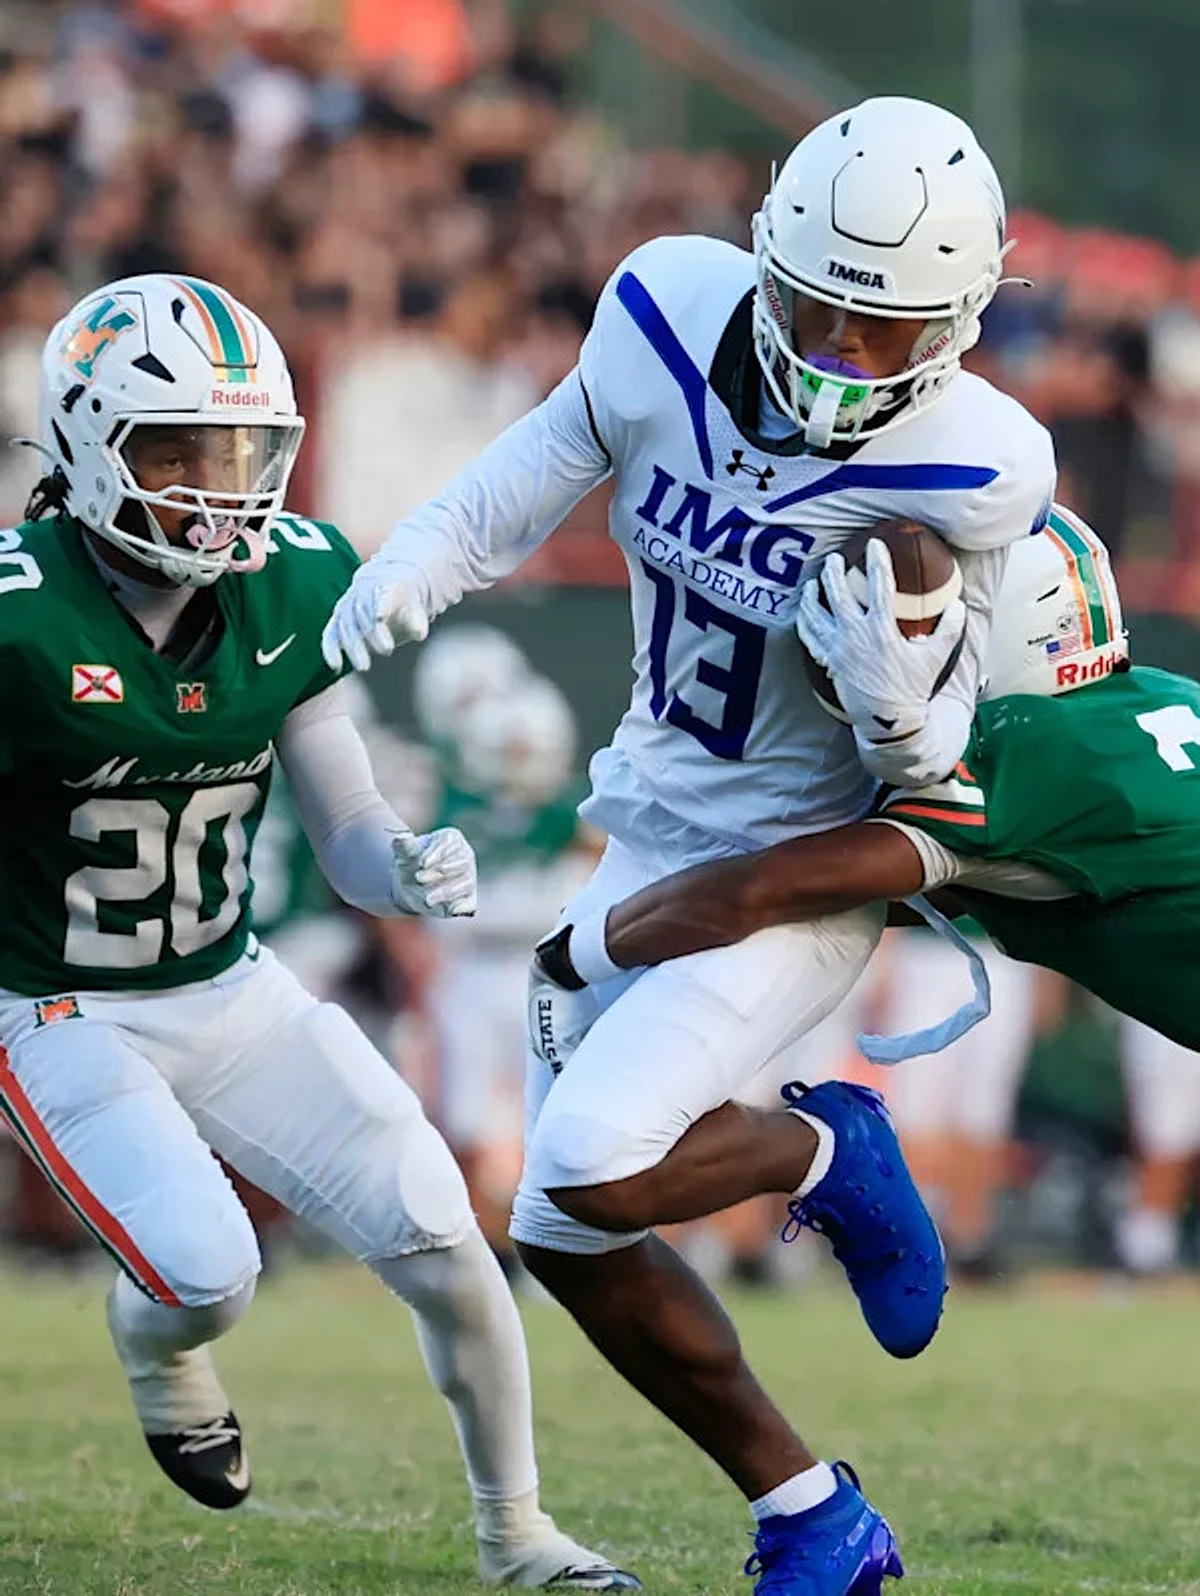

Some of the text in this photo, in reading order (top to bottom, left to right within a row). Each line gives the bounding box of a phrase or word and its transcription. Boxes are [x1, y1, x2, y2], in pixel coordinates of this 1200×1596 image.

[827, 260, 886, 290] IMGA
[210, 389, 271, 408] Riddell
[635, 464, 816, 589] IMG
[633, 527, 791, 616] ACADEMY
[640, 556, 767, 761] 13
[1056, 651, 1123, 687] Ridd
[63, 781, 262, 969] 20
[537, 1000, 557, 1059] STATE
